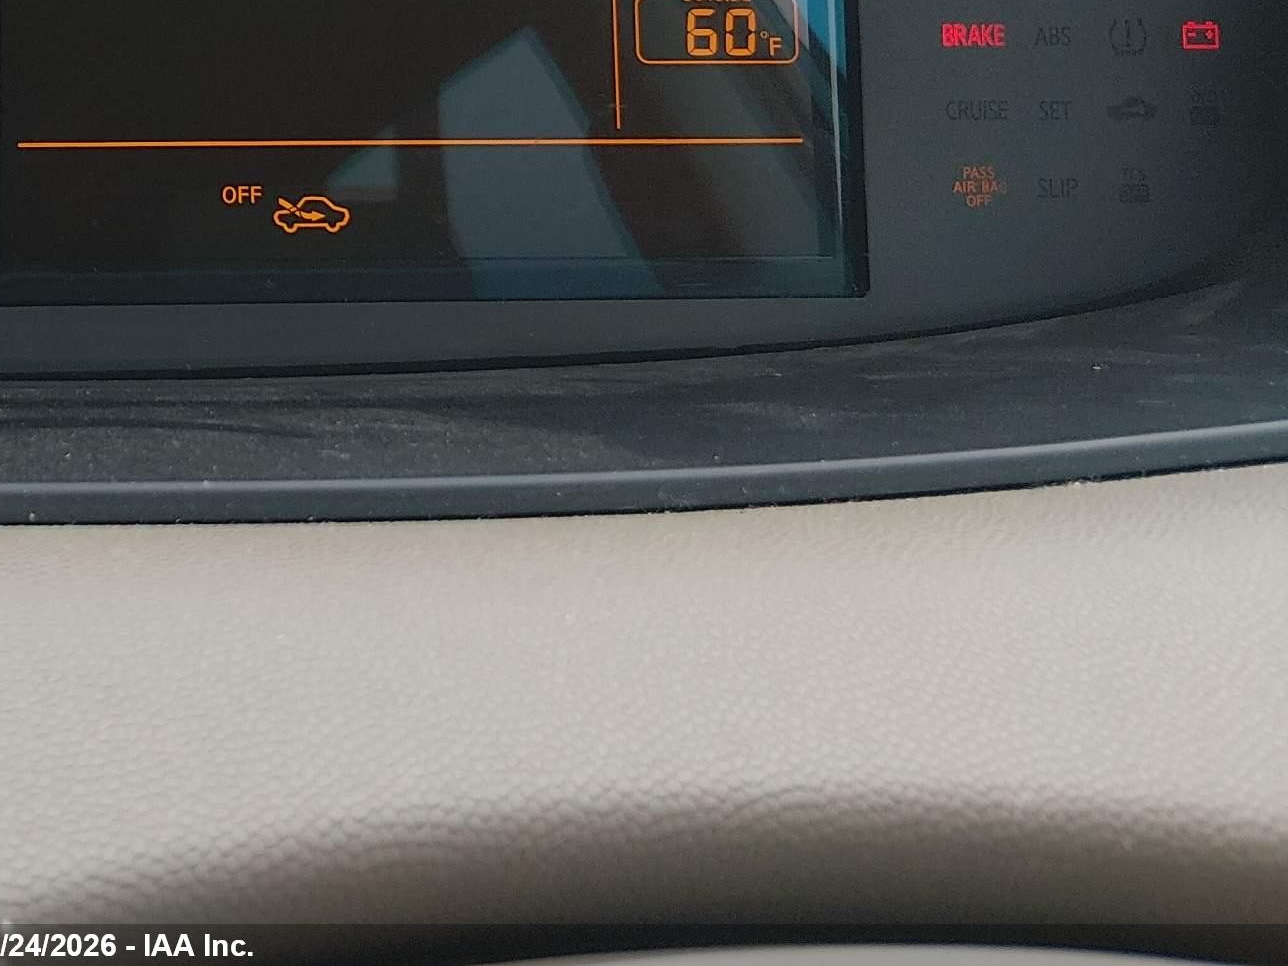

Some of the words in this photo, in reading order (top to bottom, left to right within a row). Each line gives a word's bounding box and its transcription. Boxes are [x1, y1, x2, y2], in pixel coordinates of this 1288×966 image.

[941, 22, 1005, 48] BRAKE
[1034, 27, 1072, 46] ABS
[945, 101, 1008, 121] CRUISE
[1039, 101, 1072, 121] SET
[963, 166, 995, 179] PASS
[222, 185, 262, 204] OFF
[953, 181, 976, 193] AIR
[1038, 178, 1079, 199] SLIP
[966, 194, 992, 207] OFF
